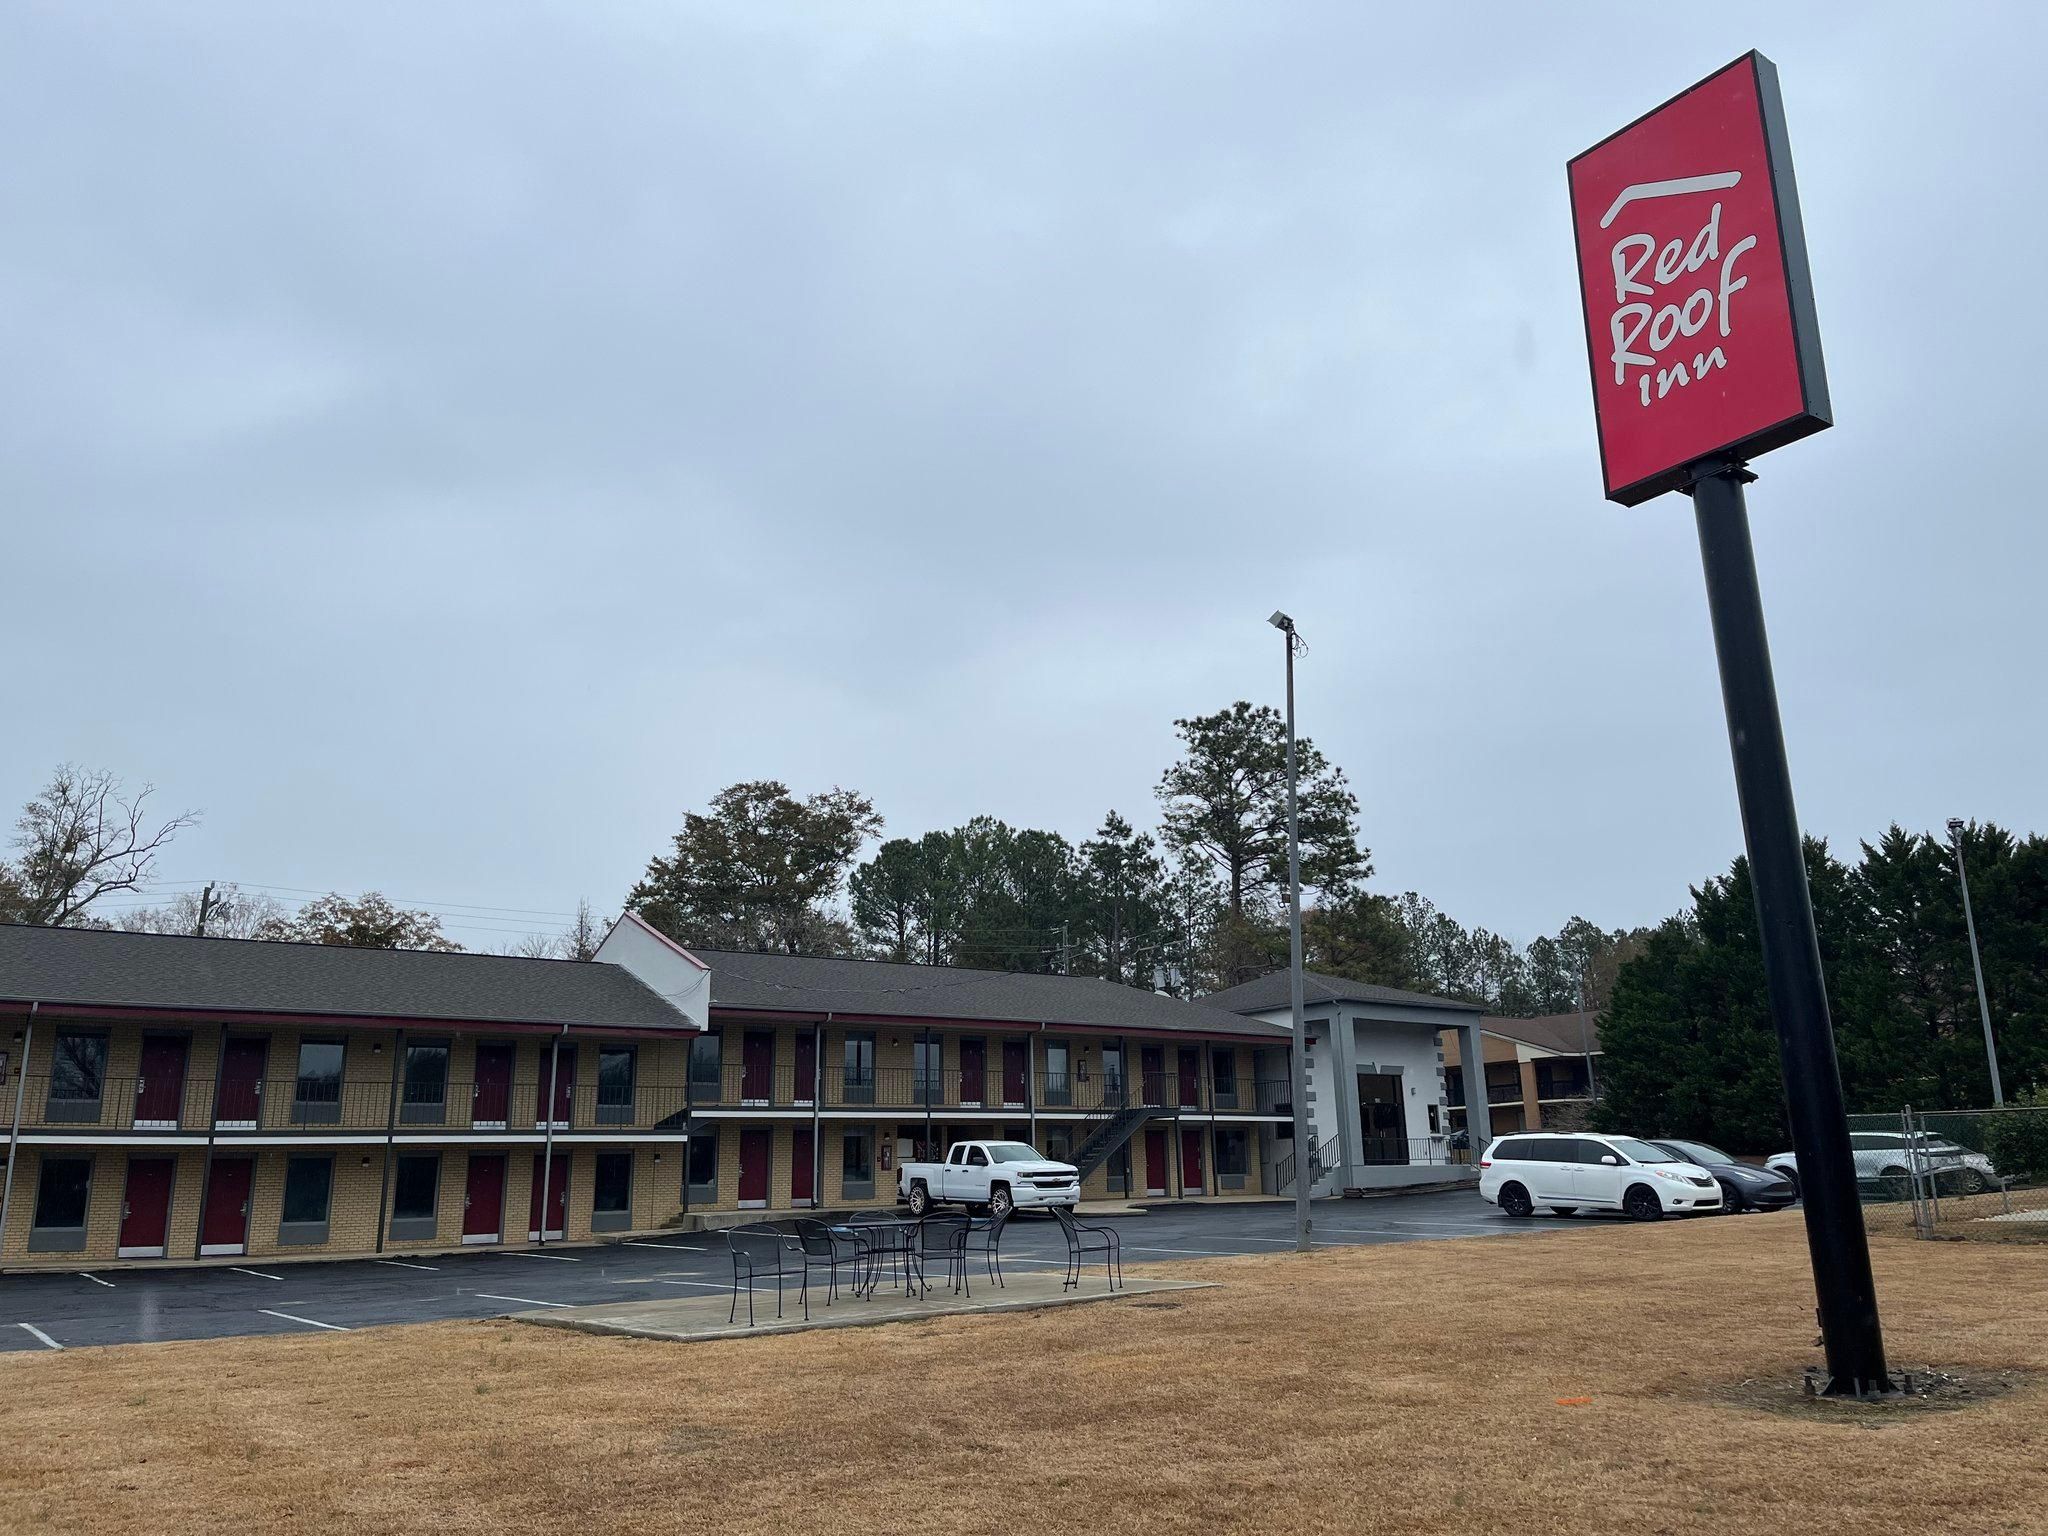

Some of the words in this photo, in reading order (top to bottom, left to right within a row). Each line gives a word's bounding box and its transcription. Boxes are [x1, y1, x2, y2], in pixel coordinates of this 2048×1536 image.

[1611, 202, 1722, 304] Red
[1610, 235, 1757, 386] Roof
[1639, 346, 1728, 407] inn
